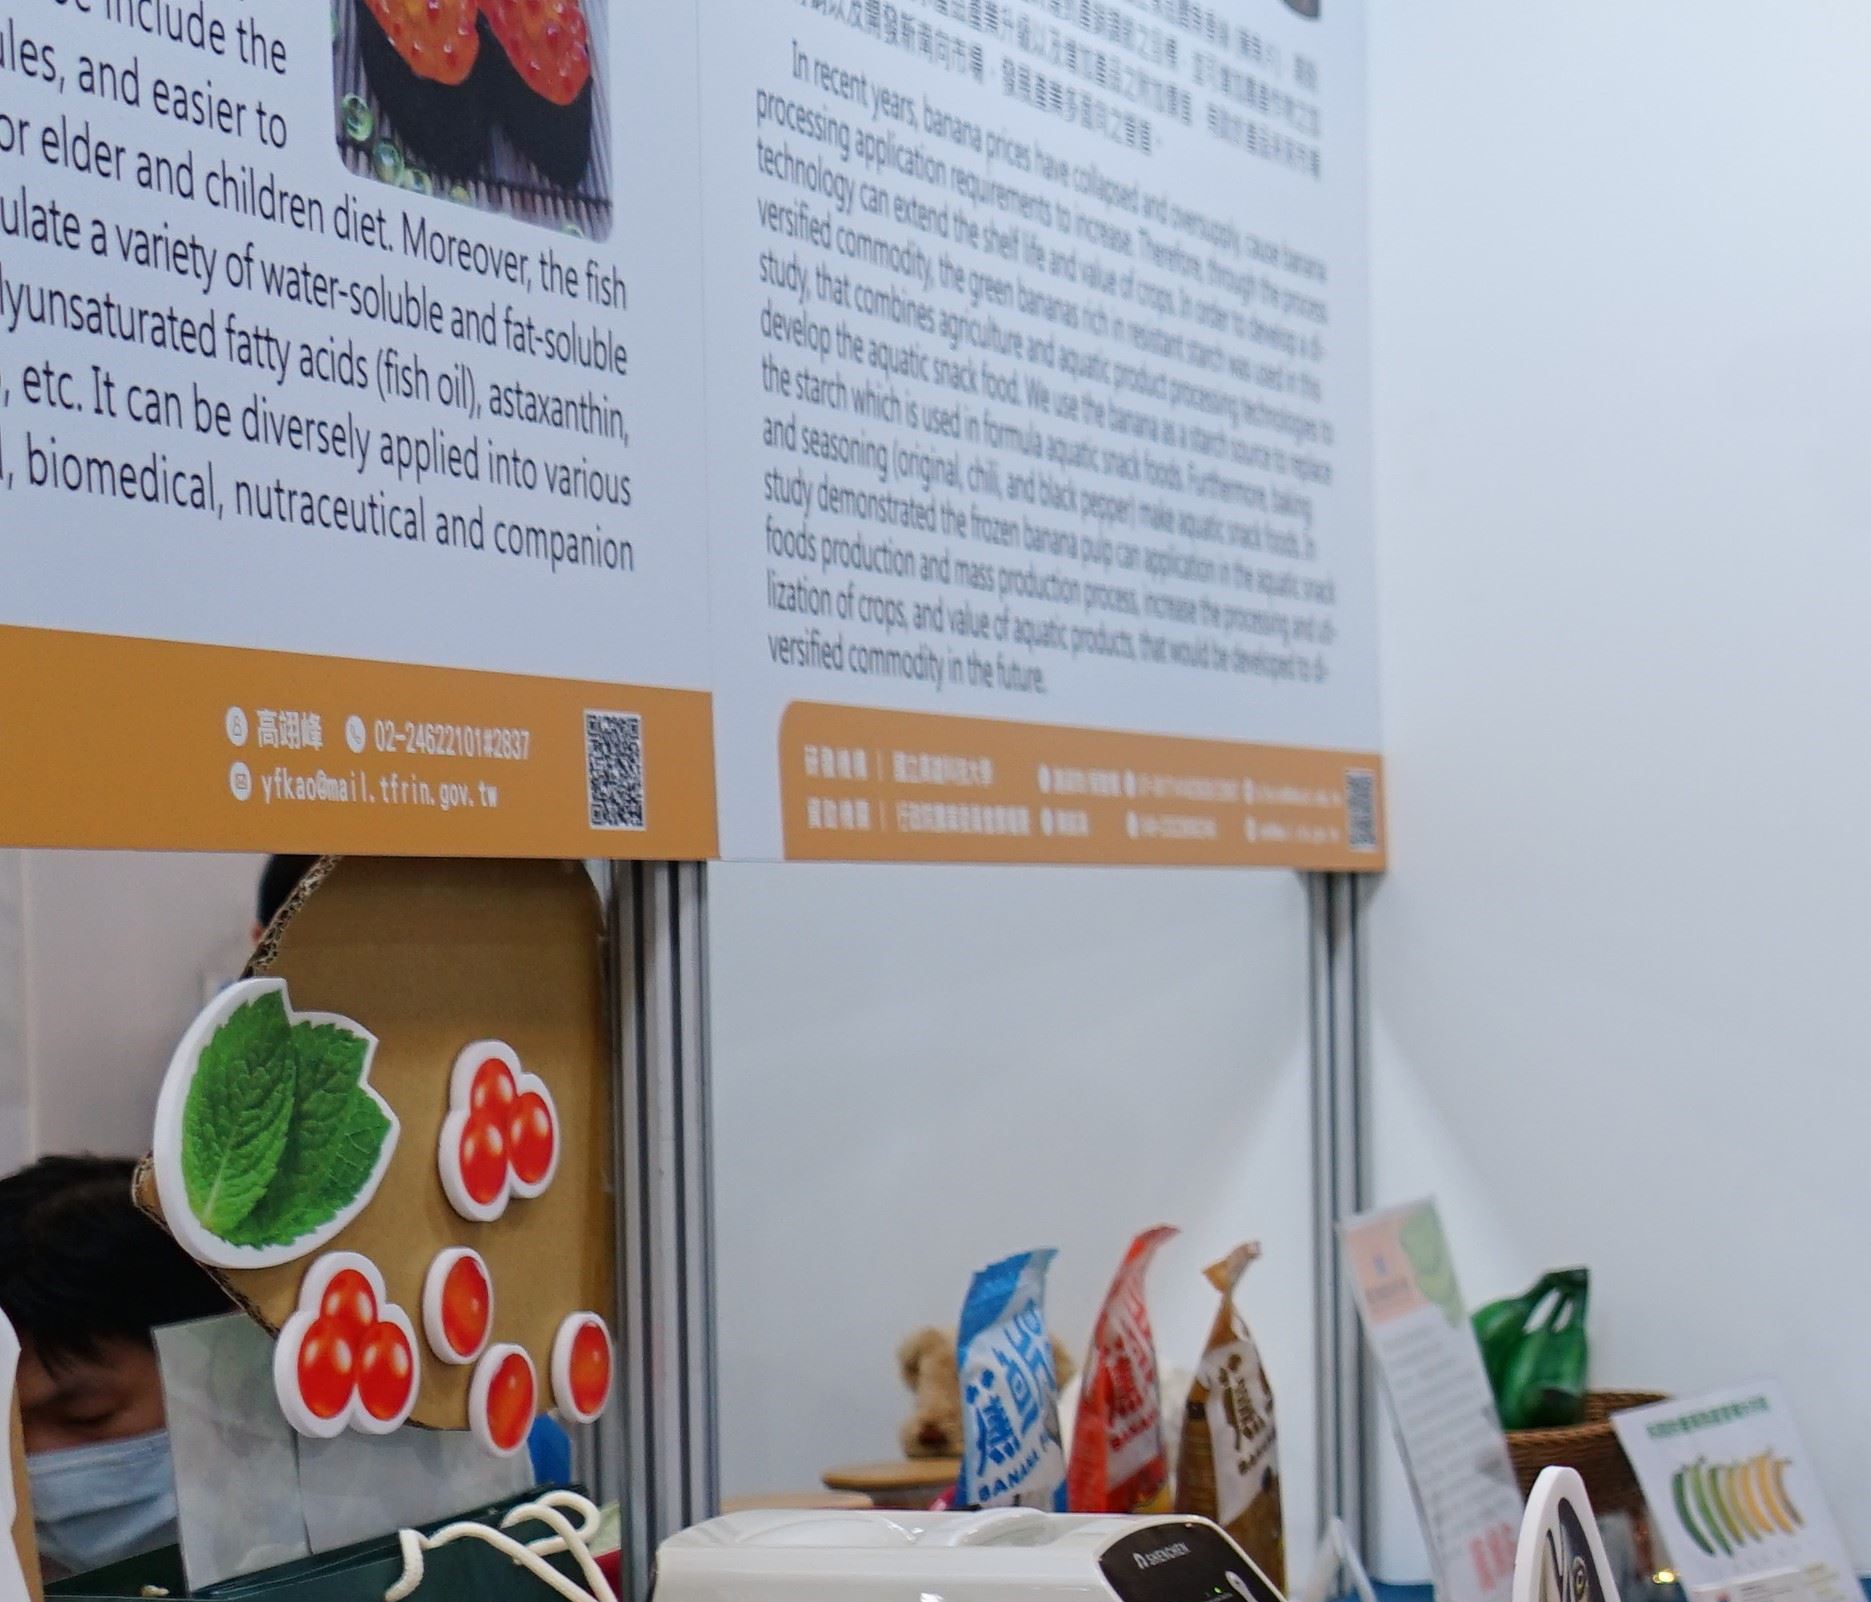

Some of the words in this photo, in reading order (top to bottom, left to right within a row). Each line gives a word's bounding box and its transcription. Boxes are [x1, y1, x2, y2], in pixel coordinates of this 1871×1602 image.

[236, 17, 285, 74] the
[792, 40, 809, 86] In
[813, 59, 867, 108] recent
[872, 82, 918, 133] years,
[78, 55, 139, 107] and
[152, 78, 246, 136] easier
[255, 101, 286, 148] to
[755, 91, 850, 164] processing
[855, 128, 946, 188] application
[41, 114, 125, 180] elder
[136, 150, 193, 200] and
[205, 159, 323, 233] children
[334, 193, 392, 251] diet.
[402, 211, 530, 291] Moreover,
[539, 249, 577, 298] the
[585, 259, 625, 308] fish
[757, 141, 854, 218] technology
[859, 182, 889, 219] can
[893, 193, 949, 239] extend
[758, 201, 831, 253] versified
[836, 226, 933, 293] commodity,
[90, 218, 106, 256] a
[115, 221, 216, 292] variety
[225, 241, 254, 290] of
[260, 260, 443, 334] water-soluble
[451, 302, 496, 345] and
[503, 305, 626, 375] fat-soluble
[759, 253, 811, 309] study,
[816, 264, 849, 310] that
[854, 284, 934, 334] combines
[225, 312, 290, 385] fatty
[299, 335, 368, 389] acids
[376, 347, 429, 401] (fish
[437, 363, 480, 418] oil),
[489, 381, 627, 445] astaxanthin,
[760, 300, 831, 368] develop
[836, 323, 863, 366] the
[868, 340, 927, 383] aquatic
[22, 360, 82, 411] etc.
[91, 364, 116, 417] It
[127, 385, 182, 428] can
[193, 382, 231, 437] be
[241, 393, 370, 474] diversely
[380, 427, 478, 483] applied
[488, 439, 536, 490] into
[544, 457, 630, 506] various
[762, 356, 791, 400] the
[795, 370, 847, 413] starch
[852, 381, 901, 426] which
[905, 393, 918, 430] is
[922, 402, 961, 440] used
[763, 413, 796, 455] and
[802, 428, 888, 484] seasoning
[892, 438, 963, 495] (original,
[26, 431, 222, 520] biomedical,
[235, 479, 425, 541] nutraceutical
[436, 505, 484, 550] and
[494, 522, 632, 572] companion
[764, 468, 813, 521] study
[817, 473, 936, 533] demonstrated
[765, 516, 816, 563] foods
[821, 531, 915, 579] production
[920, 547, 950, 584] and
[766, 570, 831, 617] lization
[836, 582, 854, 620] of
[858, 593, 907, 635] crops,
[913, 595, 943, 632] and
[768, 628, 843, 670] versified
[848, 641, 945, 690] commodity
[948, 648, 963, 682] in
[261, 766, 498, 811] yfkao@mail.tfrin.gov.tw
